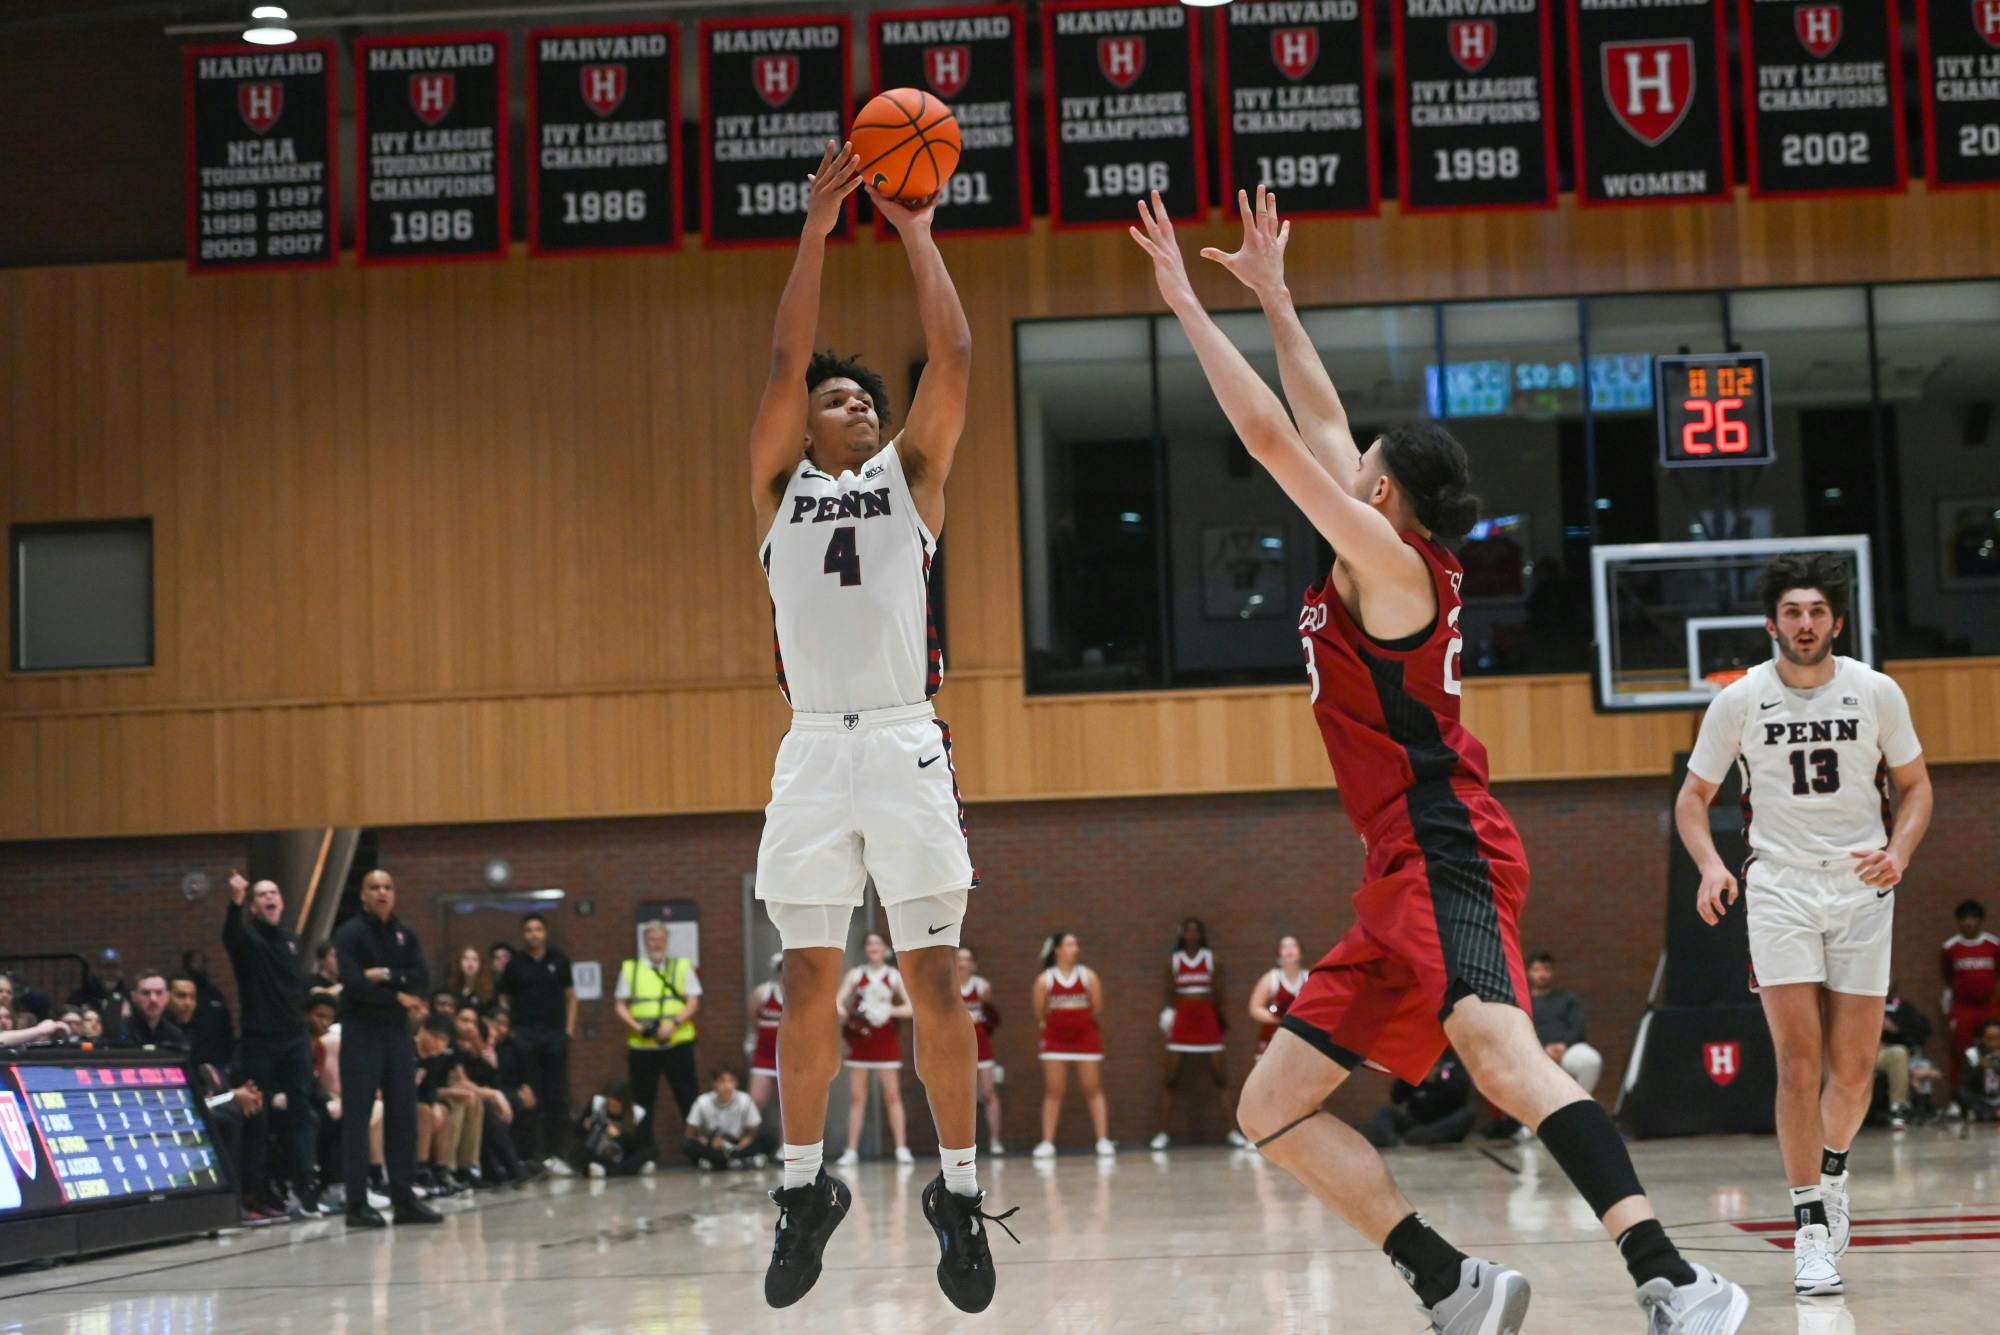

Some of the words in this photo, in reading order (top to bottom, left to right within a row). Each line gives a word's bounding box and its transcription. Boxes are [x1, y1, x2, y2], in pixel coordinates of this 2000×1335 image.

[1057, 7, 1184, 34] HARVARD
[1228, 0, 1357, 24] HARVARD
[1408, 0, 1535, 16] HARVARD
[713, 27, 838, 52] HARVARD
[883, 17, 1010, 43] HARVARD
[1459, 25, 1484, 59] H
[370, 44, 494, 70] HARVARD
[541, 35, 666, 61] HARVARD
[1109, 43, 1134, 75] H
[1283, 34, 1307, 66] H
[200, 53, 322, 78] HARVARD
[764, 61, 788, 93] H
[934, 52, 959, 84] H
[1760, 67, 1796, 87] IVY
[1802, 63, 1883, 86] LEAGUE
[1938, 57, 1974, 77] IVY
[420, 79, 444, 110] H
[591, 69, 615, 102] H
[1413, 82, 1449, 105] IVY
[1455, 77, 1536, 102] LEAGUE
[1624, 50, 1674, 116] H
[250, 85, 273, 119] H
[1063, 98, 1099, 121] IVY
[1105, 92, 1186, 118] LEAGUE
[1235, 89, 1271, 109] IVY
[1277, 85, 1358, 110] LEAGUE
[1759, 87, 1887, 111] CHAMPIONS
[717, 116, 753, 137] IVY
[758, 112, 838, 136] LEAGUE
[1234, 108, 1361, 133] CHAMPIONS
[1412, 101, 1540, 126] CHAMPIONS
[372, 133, 407, 154] IVY
[413, 128, 492, 153] LEAGUE
[544, 125, 579, 145] IVY
[585, 120, 664, 144] LEAGUE
[1062, 115, 1189, 142] CHAMPIONS
[228, 139, 299, 167] NCAA
[542, 143, 667, 169] CHAMPIONS
[1783, 133, 1868, 165] 2002
[372, 150, 493, 178] TOURNAMENT
[1257, 155, 1339, 189] 1997
[1436, 148, 1519, 180] 1998
[371, 174, 494, 200] CHAMPIONS
[1086, 162, 1168, 199] 1996
[1604, 171, 1706, 196] WOMEN
[565, 190, 645, 223] 1986
[392, 210, 472, 242] 1986
[1682, 398, 1749, 455] 26
[790, 487, 891, 524] PENN
[823, 526, 862, 587] 4
[1764, 719, 1859, 745] PENN
[1789, 748, 1841, 796] 13
[1710, 1045, 1735, 1075] H
